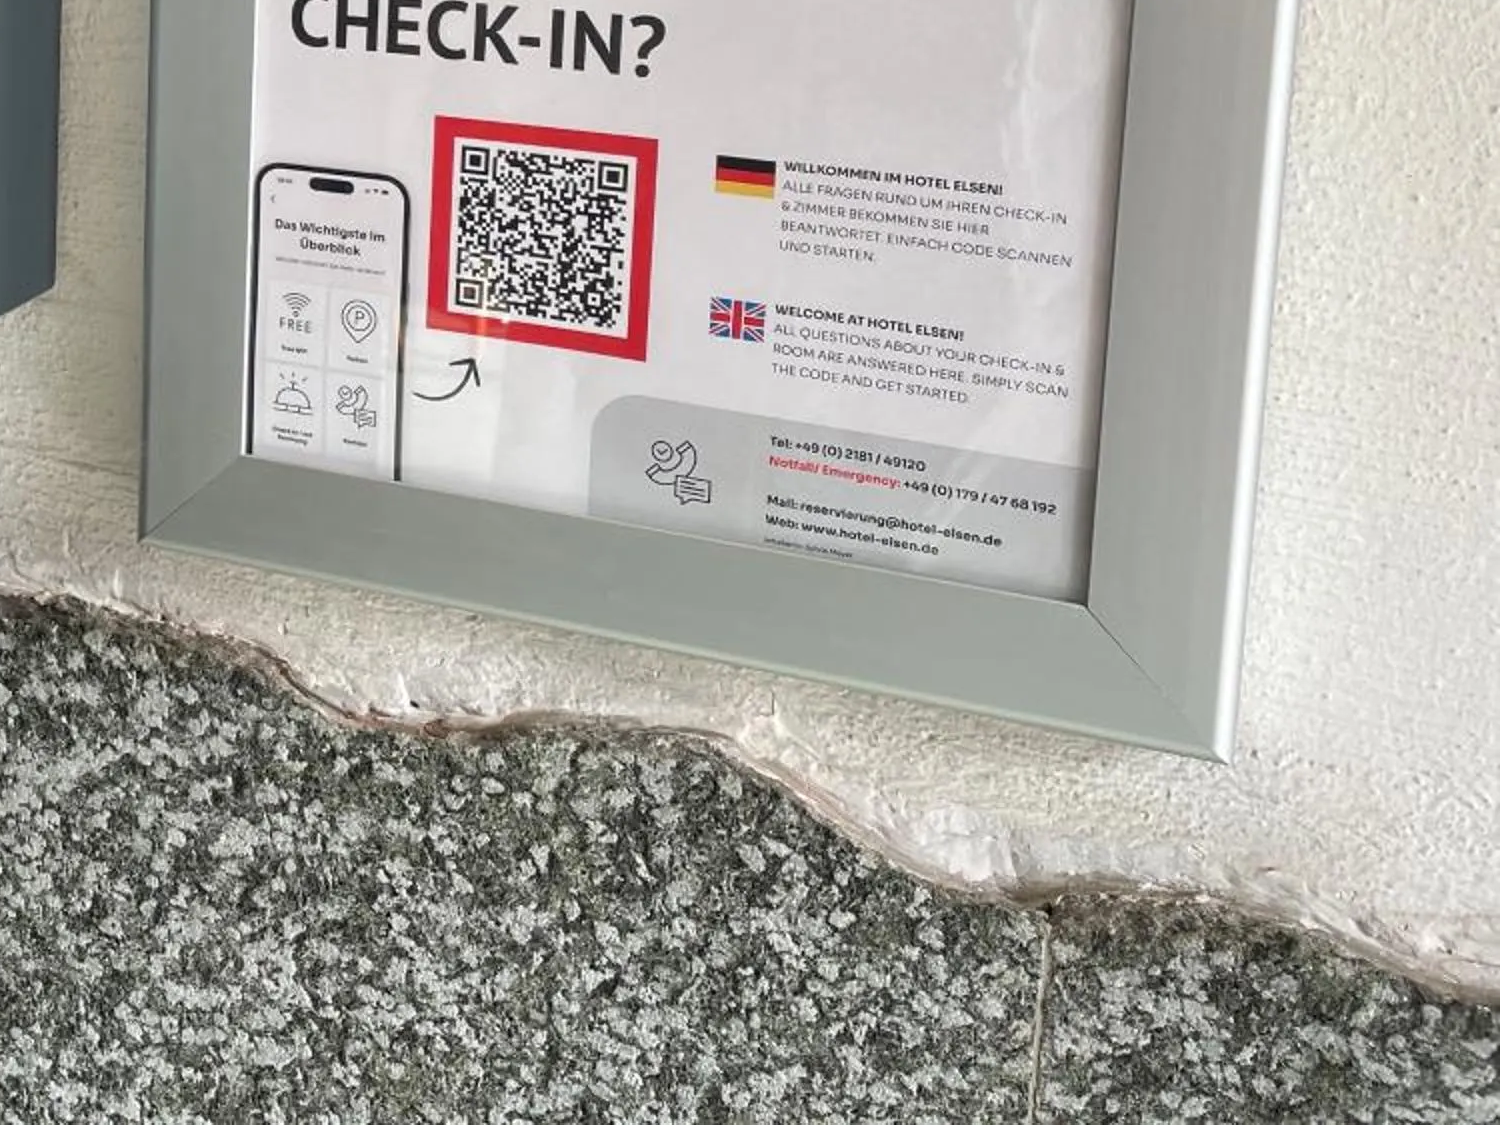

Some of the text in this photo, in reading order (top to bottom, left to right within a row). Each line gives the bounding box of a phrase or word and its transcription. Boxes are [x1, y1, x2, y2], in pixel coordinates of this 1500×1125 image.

[784, 160, 1003, 195] WILLKOMMEN IM HOTEL ELSEN!
[781, 200, 989, 236] & ZIMMER BEKOMMEN SIE HIER
[782, 178, 1067, 225] ALLE FRAGEN RUND UM IHREN CHECK-IN
[275, 218, 386, 243] Das Wichtigste im
[300, 236, 361, 257] Überblick
[779, 239, 811, 254] UND
[887, 232, 949, 252] EINFACH
[951, 242, 993, 258] CODE
[996, 247, 1073, 268] SCANNEN
[279, 316, 312, 334] FREE
[775, 304, 964, 341] WELCOME AT HOTEL ELSEN!
[774, 322, 795, 336] ALL
[800, 326, 881, 348] QUESTIONS
[883, 338, 932, 356] ABOUT
[935, 347, 977, 363] YOUR
[979, 353, 1051, 375] CHECK-IN
[771, 362, 797, 377] THE
[799, 366, 839, 384] CODE
[841, 374, 873, 389] AND
[875, 379, 903, 392] GET
[772, 342, 815, 358] ROOM
[817, 350, 845, 364] ARE
[847, 354, 927, 377] ANSWERED
[971, 372, 1023, 391] SIMPLY
[1025, 380, 1069, 399] SCAN
[771, 436, 793, 450] Tel:
[796, 442, 820, 455] +49
[822, 444, 843, 460] (0)
[845, 448, 873, 462] 2181
[883, 456, 926, 472] 49120
[822, 465, 900, 489] Emergency:
[903, 480, 929, 493] +49
[931, 483, 953, 499] (0)
[956, 488, 979, 501] 179
[990, 494, 1008, 506] 47
[1010, 498, 1029, 510] 68
[1032, 500, 1057, 515] 192
[765, 514, 799, 530] Web:
[801, 522, 939, 555] www.hotel-elsen.de
[767, 494, 1003, 547] Mail: reservierung@hotel-elsen.de
